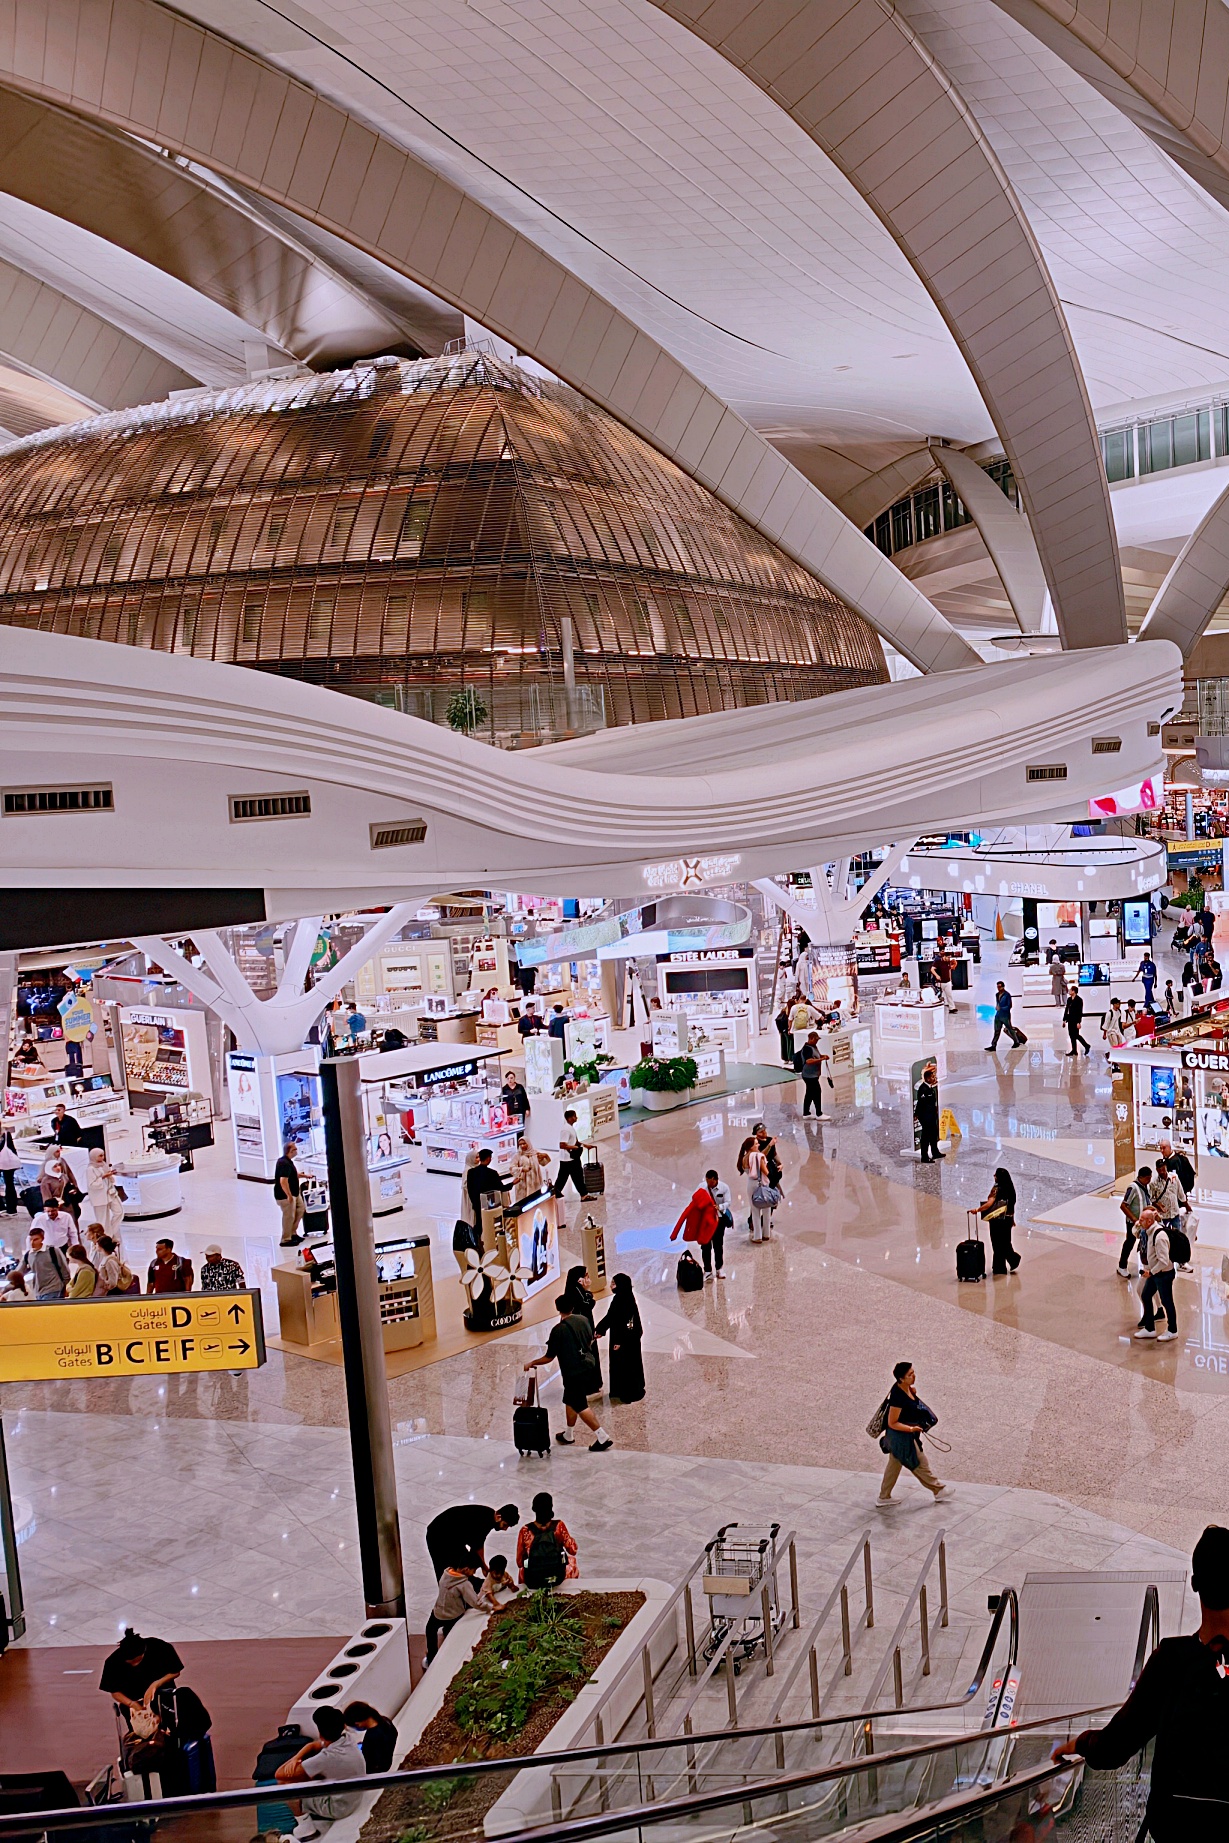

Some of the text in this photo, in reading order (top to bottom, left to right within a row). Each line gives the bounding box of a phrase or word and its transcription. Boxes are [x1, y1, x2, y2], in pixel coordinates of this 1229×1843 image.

[1010, 882, 1048, 895] CHANEL
[384, 945, 416, 953] GUCCI
[701, 950, 739, 960] LAUDER
[130, 1014, 165, 1026] GUERLAIN
[424, 1066, 465, 1083] LANCÔME
[130, 1308, 167, 1319] البوابات
[171, 1306, 192, 1328] D
[133, 1319, 168, 1330] Gates
[54, 1344, 91, 1357] البوابات
[96, 1338, 194, 1365] B C E F
[58, 1356, 92, 1368] Gates
